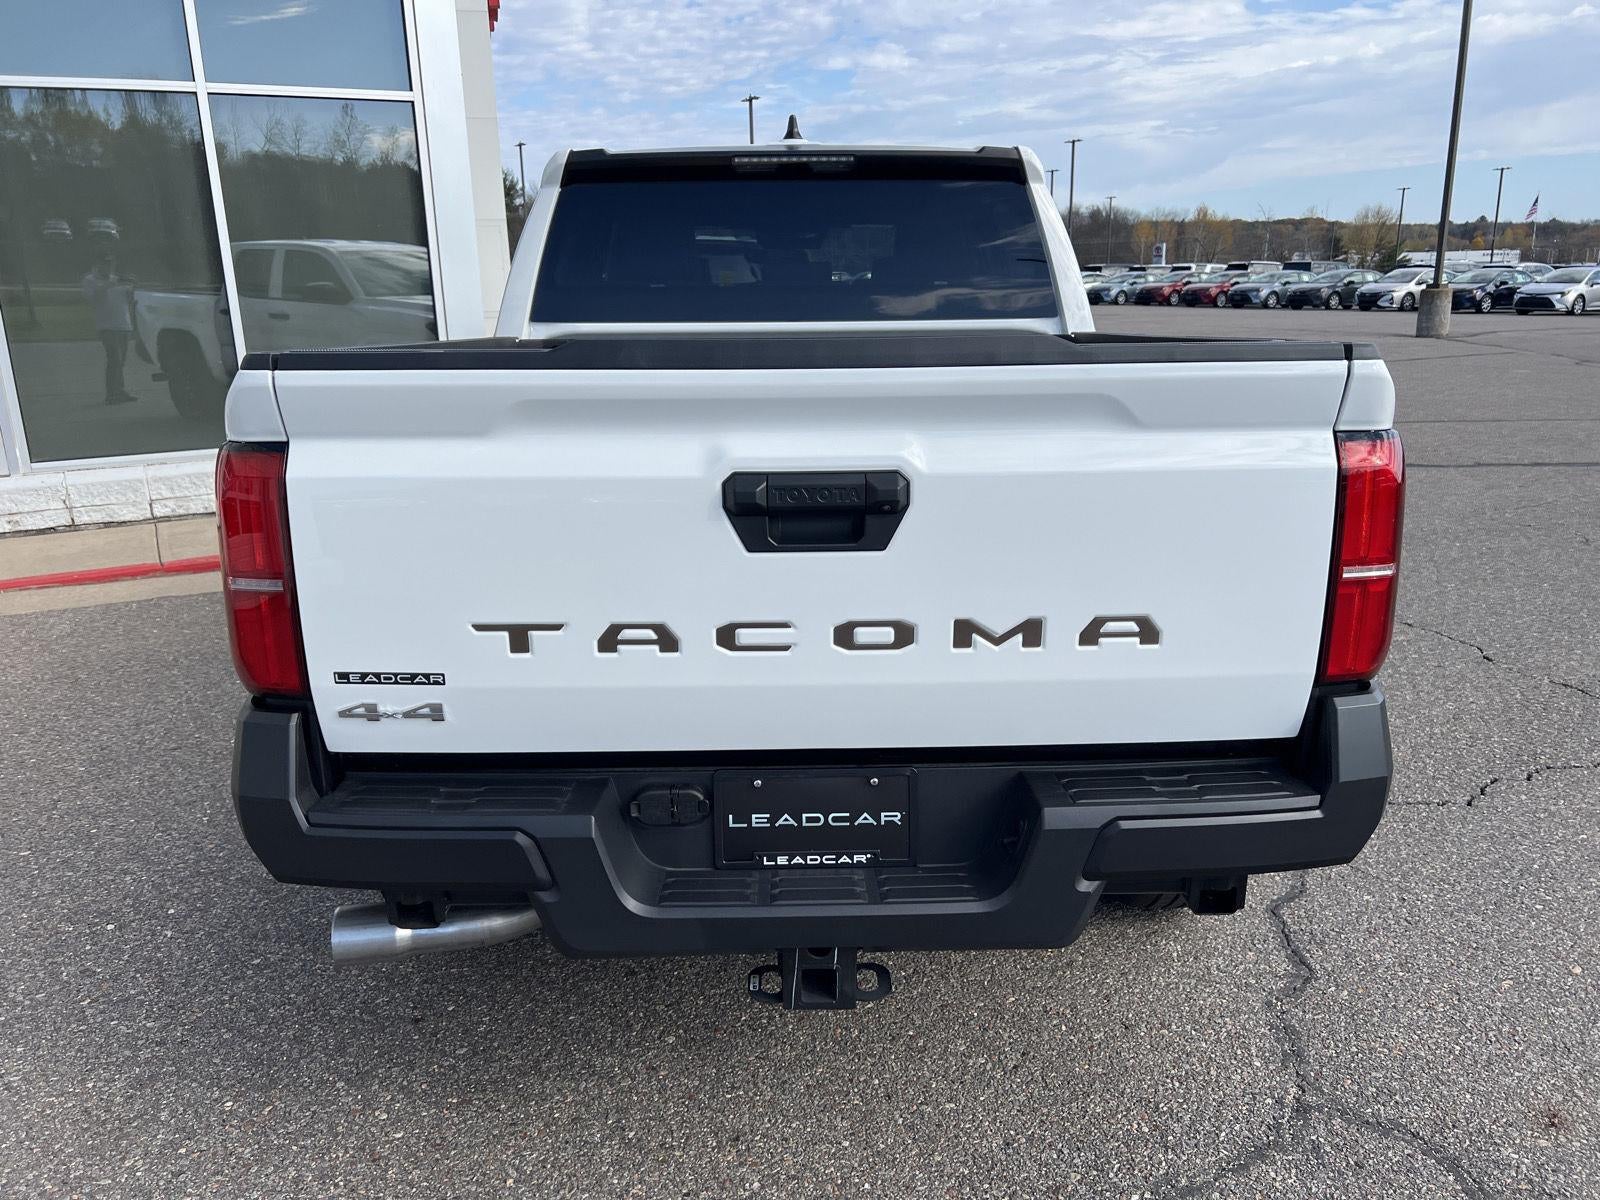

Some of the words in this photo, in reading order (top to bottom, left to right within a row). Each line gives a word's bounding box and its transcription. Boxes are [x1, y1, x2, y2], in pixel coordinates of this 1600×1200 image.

[773, 487, 860, 503] TOYOTA
[470, 614, 1162, 656] TACOMA
[335, 673, 444, 684] LEADCAR
[728, 811, 904, 828] LEADCAR
[763, 854, 871, 865] LEADCAR
